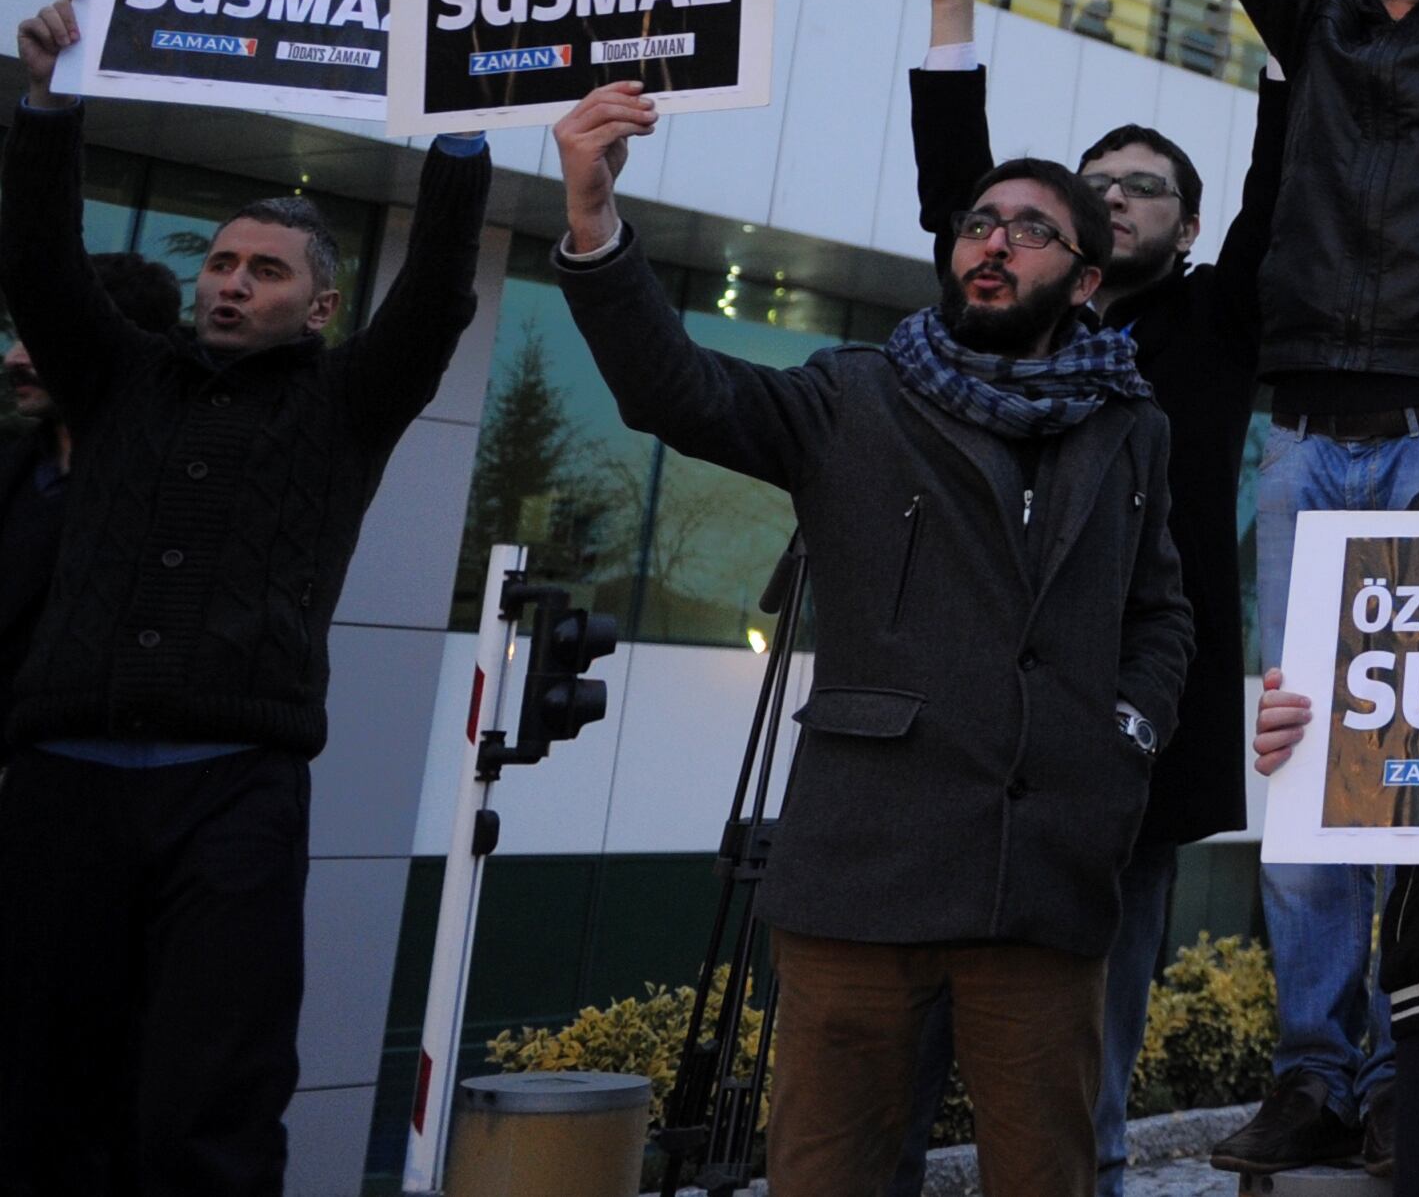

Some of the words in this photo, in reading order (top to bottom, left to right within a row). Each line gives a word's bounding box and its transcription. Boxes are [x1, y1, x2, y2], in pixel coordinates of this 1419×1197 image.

[157, 33, 235, 51] ZAMAN
[642, 38, 685, 57] ZAMAN
[327, 47, 371, 65] ZAMAN
[473, 50, 549, 71] ZAMAN
